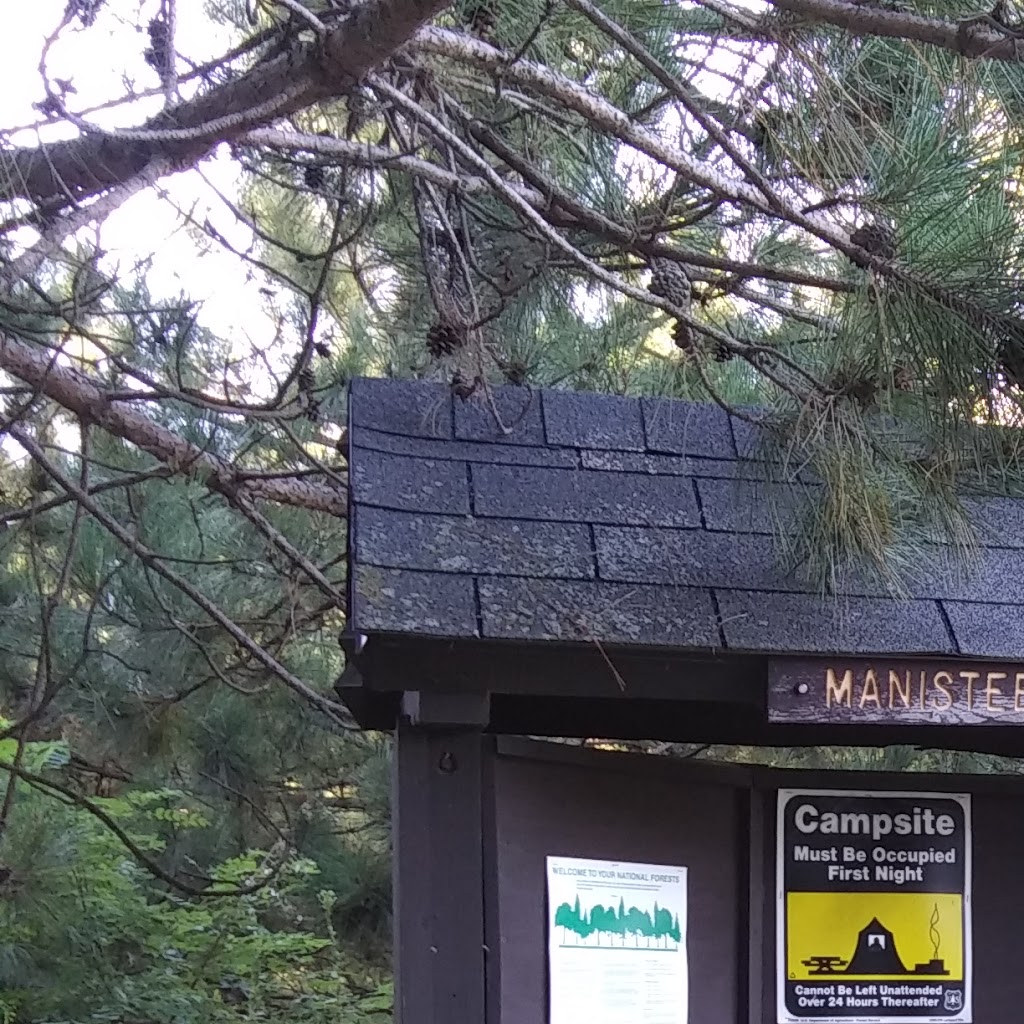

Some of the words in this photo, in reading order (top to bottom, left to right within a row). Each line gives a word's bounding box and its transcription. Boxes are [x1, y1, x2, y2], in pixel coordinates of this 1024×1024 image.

[795, 804, 955, 840] Campsite
[794, 846, 837, 862] Must
[843, 847, 866, 863] Be
[872, 847, 955, 865] Occupied
[552, 867, 587, 877] WELCOME
[588, 869, 597, 877] TO
[617, 872, 648, 881] NATIONAL
[650, 874, 680, 883] FORESTS
[828, 866, 869, 881] First
[875, 866, 923, 884] Night
[795, 985, 835, 995] Cannot
[838, 985, 852, 996] Be
[855, 985, 877, 996] Left
[880, 985, 943, 996] Unattended
[798, 997, 825, 1007] Over
[828, 997, 843, 1006] 24
[846, 997, 878, 1007] Hours
[881, 997, 939, 1008] Thereafter
